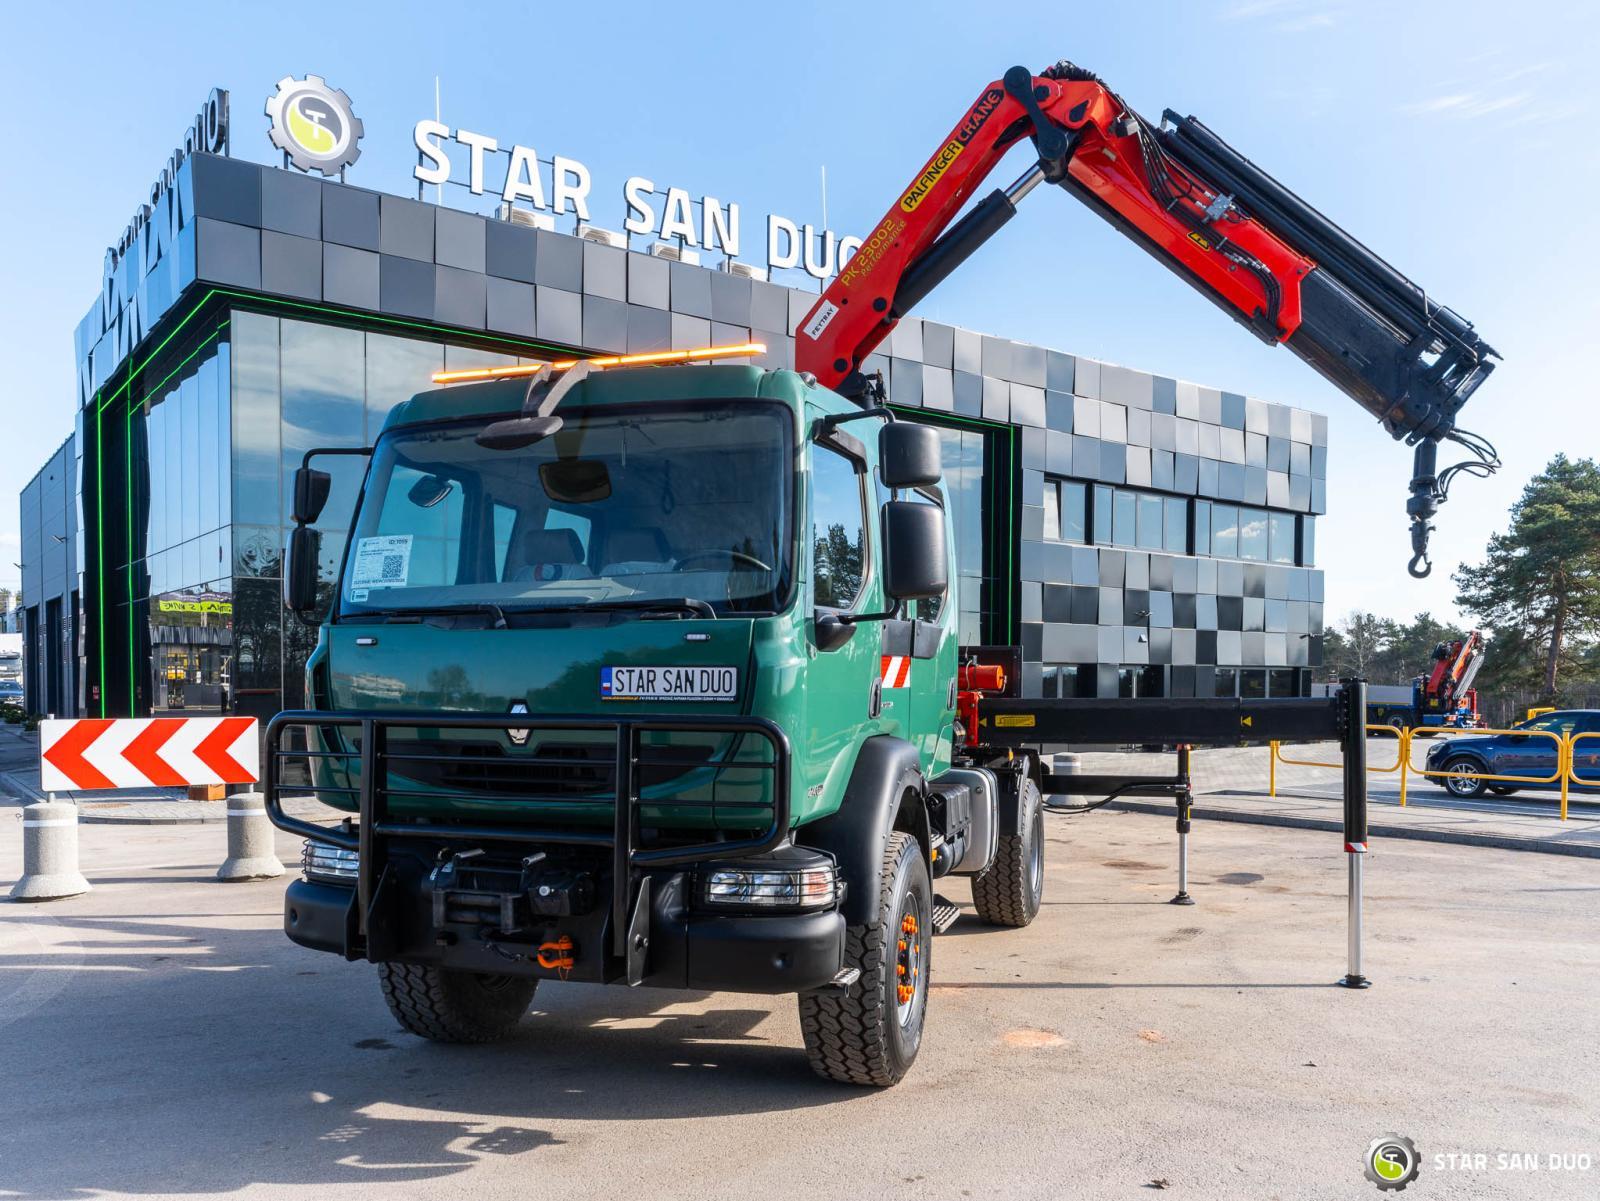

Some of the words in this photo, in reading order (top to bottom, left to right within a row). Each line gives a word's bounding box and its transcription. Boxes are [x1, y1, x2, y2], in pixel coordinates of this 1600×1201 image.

[413, 119, 592, 221] STAR
[623, 176, 739, 257] SAN
[903, 141, 962, 209] PALFINGER
[957, 90, 1001, 143] CRANE
[841, 263, 861, 287] PK
[856, 218, 897, 267] 23002
[615, 669, 657, 693] STAR
[663, 669, 695, 693] SAN
[700, 669, 733, 693] DUO
